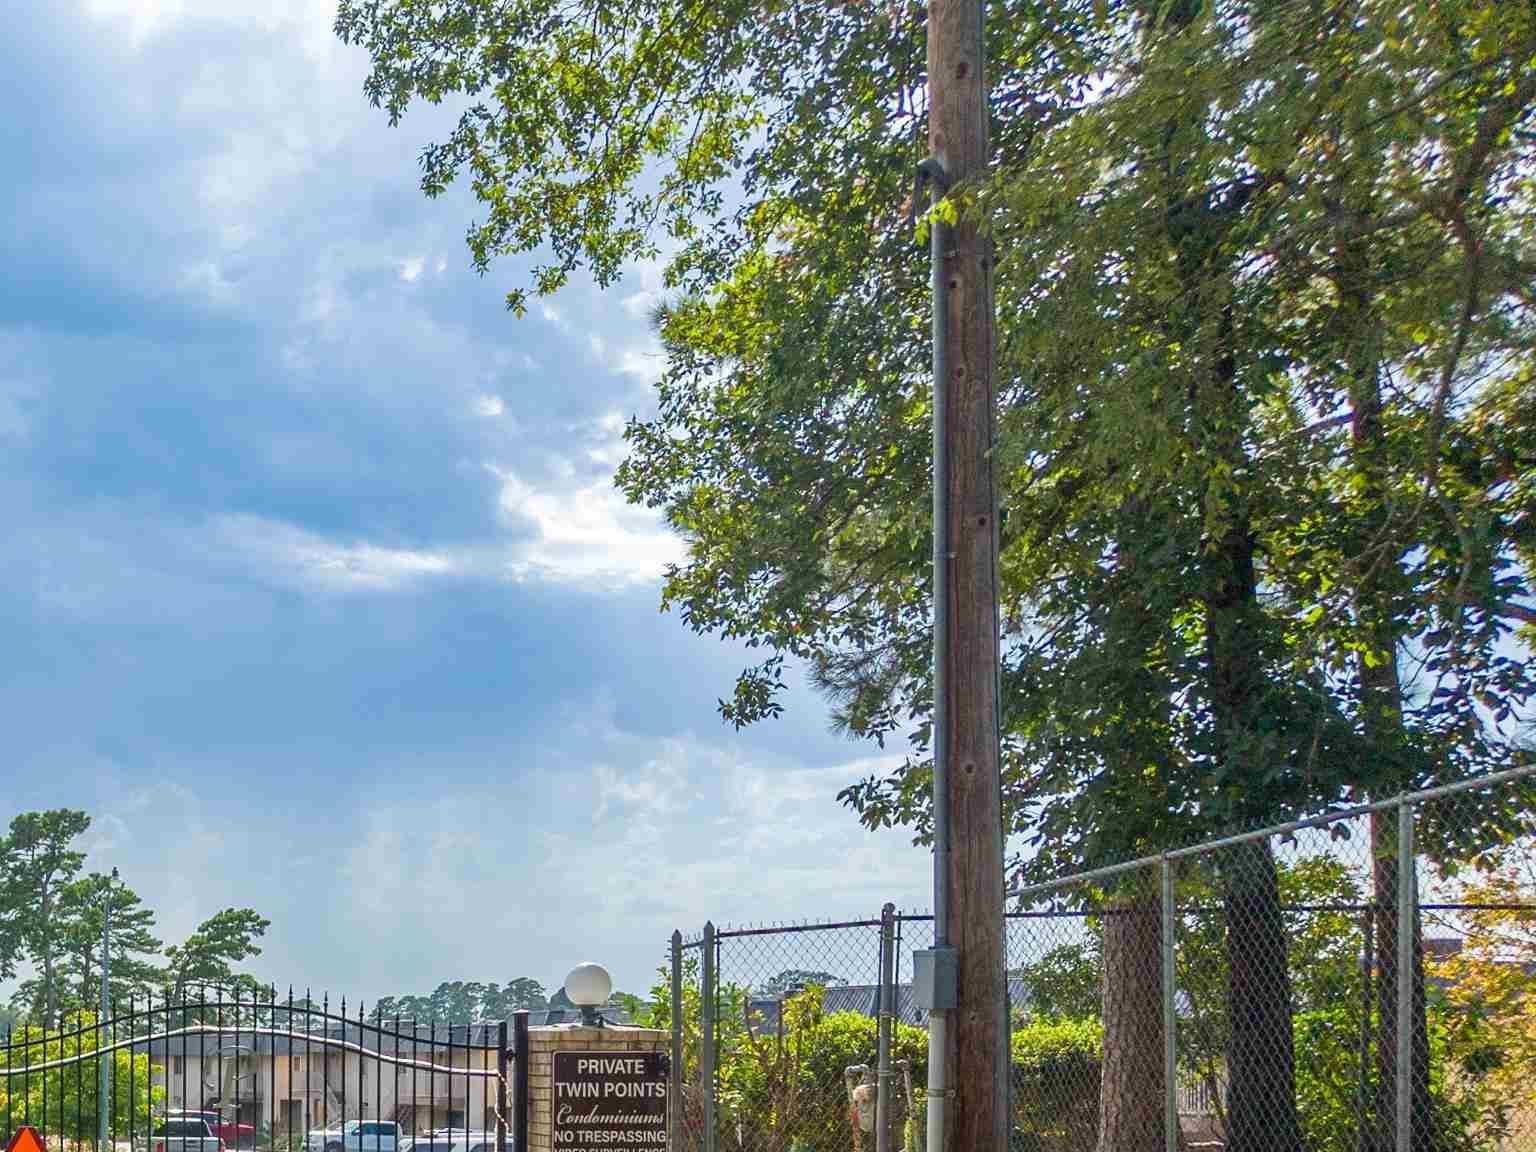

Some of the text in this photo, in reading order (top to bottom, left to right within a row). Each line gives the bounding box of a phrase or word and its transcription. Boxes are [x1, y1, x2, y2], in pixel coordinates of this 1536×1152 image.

[577, 1059, 644, 1074] PRIVATE
[555, 1082, 666, 1098] TWIN POINTS
[557, 1103, 664, 1124] Condominiums
[554, 1130, 666, 1143] NO TRESPASSING
